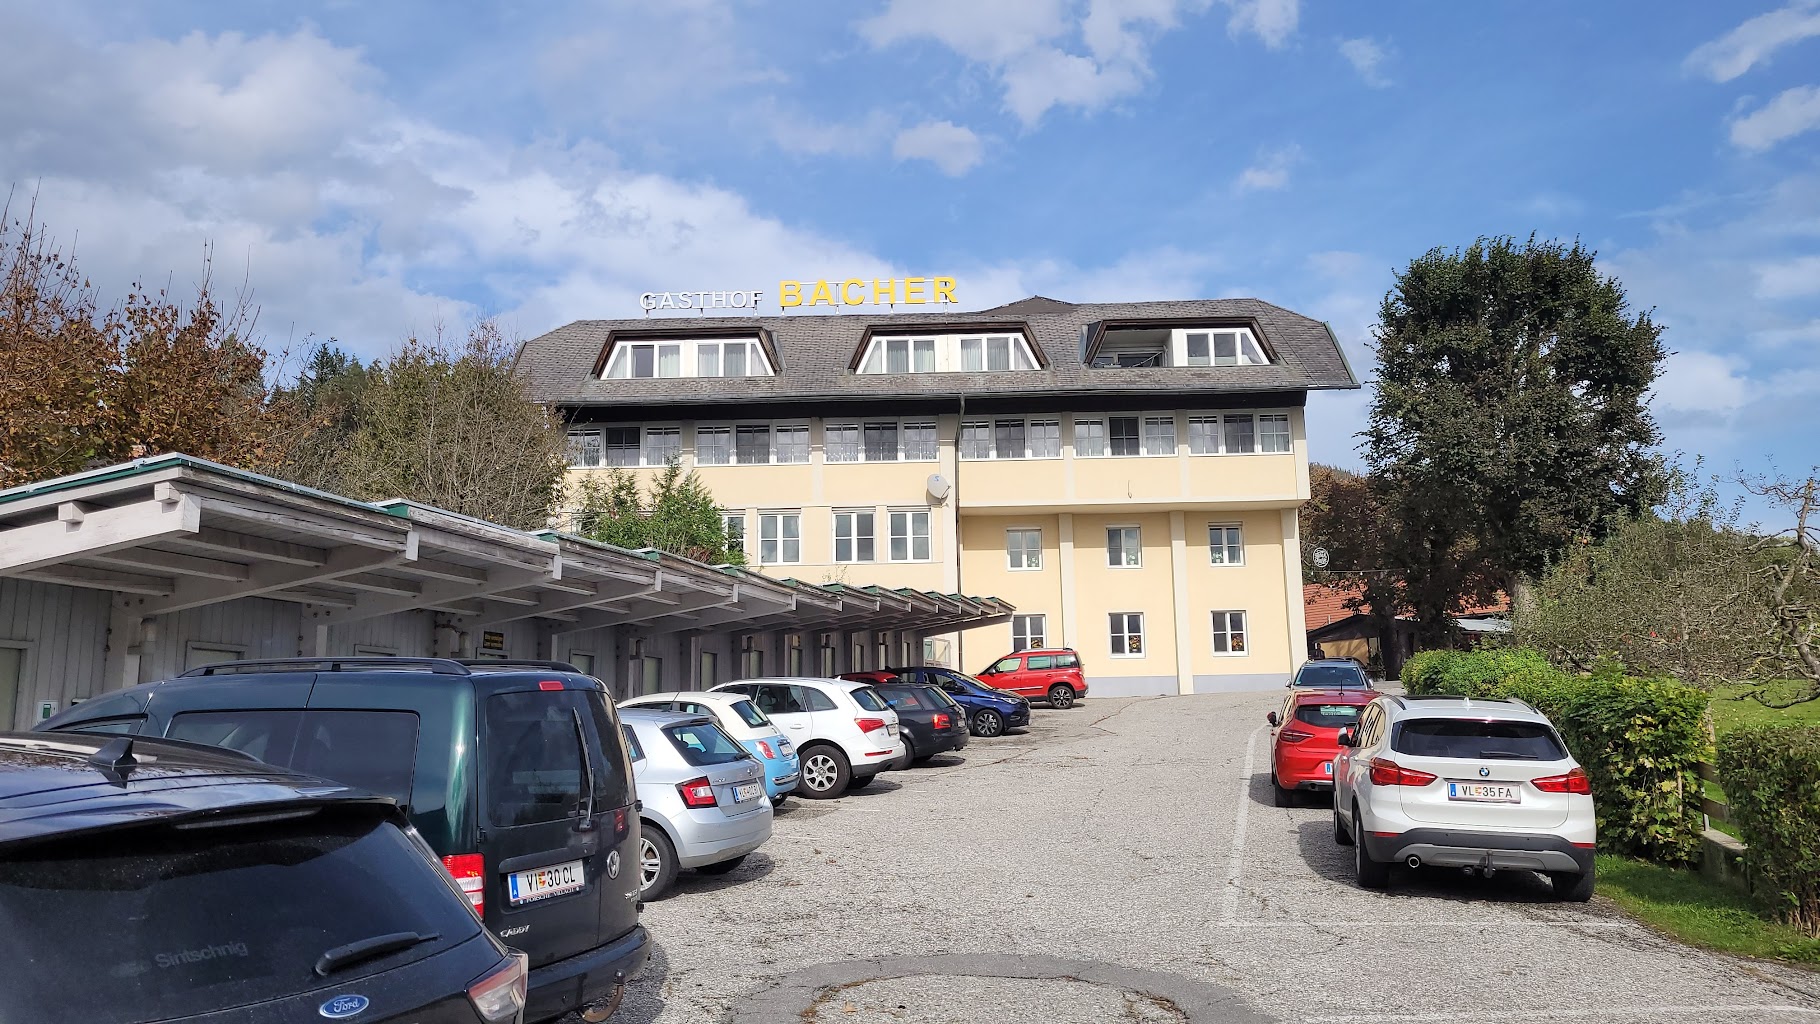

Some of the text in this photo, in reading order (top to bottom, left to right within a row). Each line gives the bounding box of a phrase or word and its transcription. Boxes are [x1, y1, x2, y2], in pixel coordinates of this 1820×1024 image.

[639, 276, 958, 311] GASTHOF BACHER
[1461, 785, 1475, 796] VL
[1482, 786, 1496, 798] 35
[1498, 787, 1513, 799] FA
[526, 873, 539, 892] VI
[547, 869, 561, 887] 30
[562, 866, 576, 884] CL
[500, 924, 530, 938] CADDY
[155, 941, 248, 968] Sintschnig
[333, 998, 360, 1013] Ford
